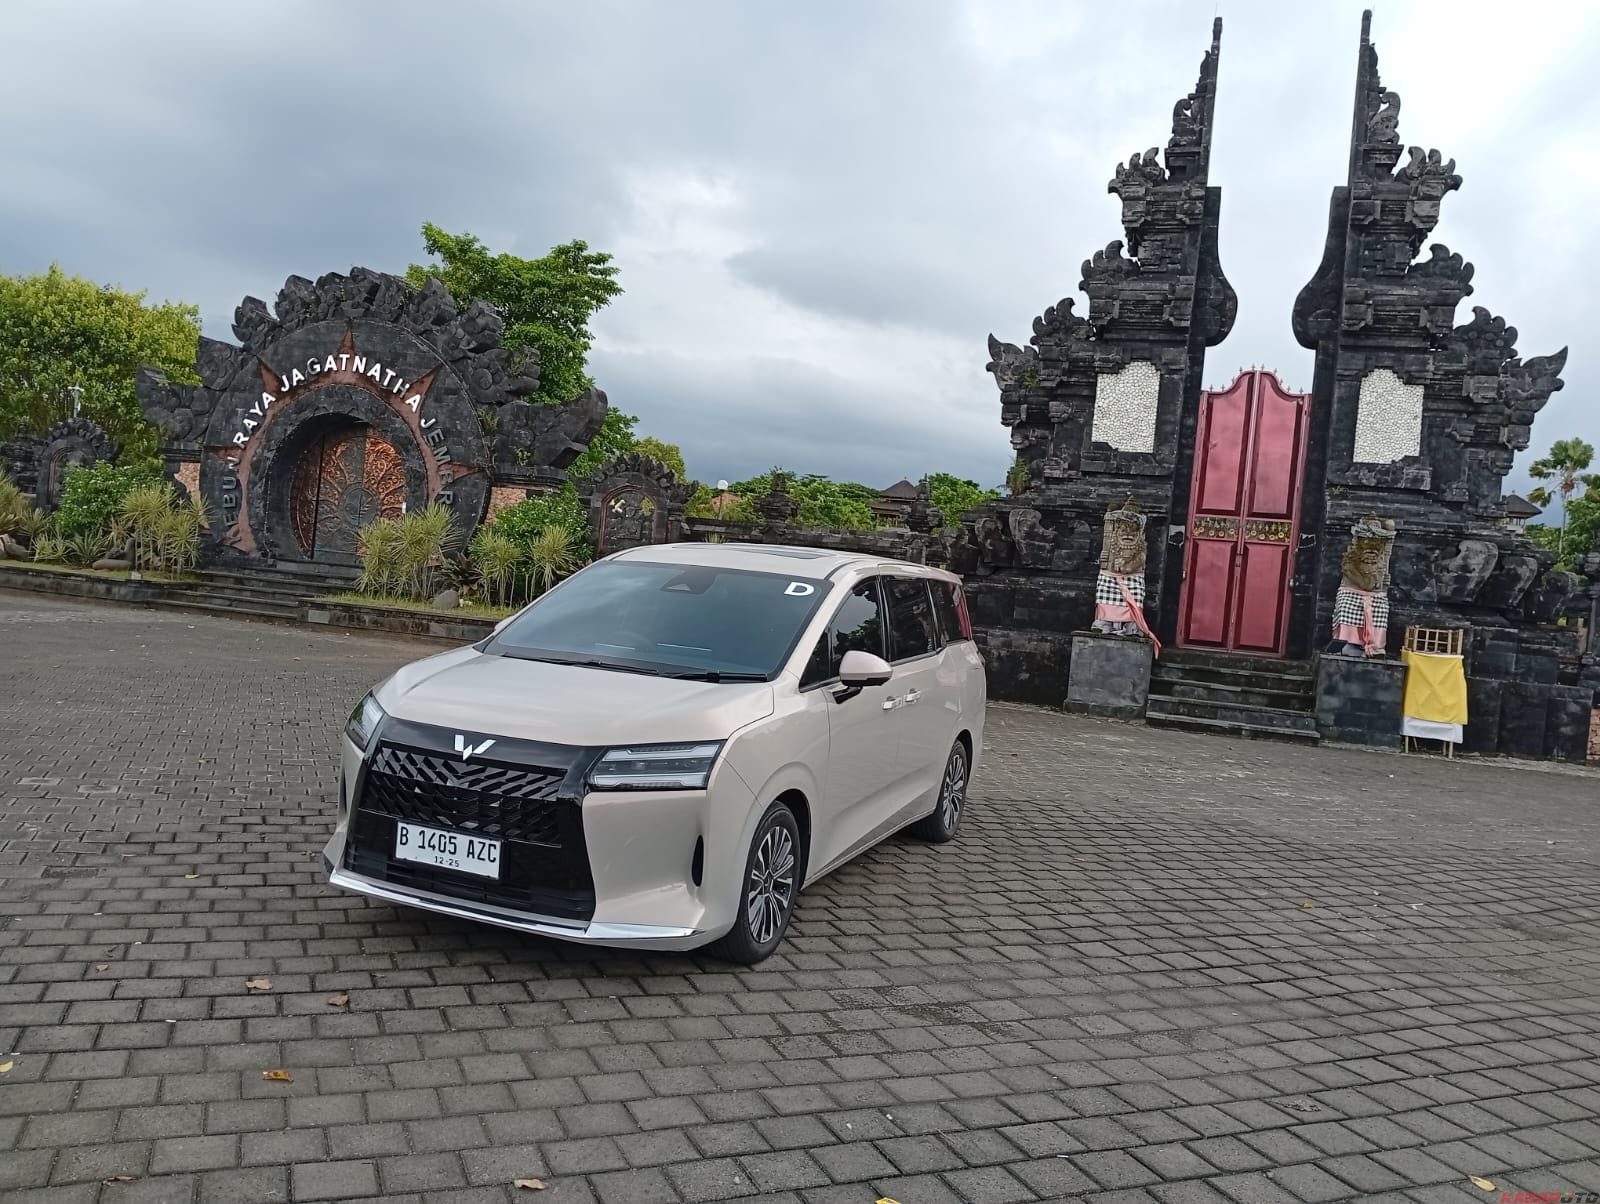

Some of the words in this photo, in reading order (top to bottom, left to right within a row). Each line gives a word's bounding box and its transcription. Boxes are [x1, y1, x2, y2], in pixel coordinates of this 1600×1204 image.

[223, 455, 241, 541] EBUN
[232, 392, 276, 449] RAYA
[281, 353, 421, 412] JAGATNATHA
[420, 418, 454, 505] JEMBR
[783, 581, 815, 597] D
[399, 826, 409, 846] B
[417, 829, 457, 855] 1405
[466, 839, 497, 863] AZC
